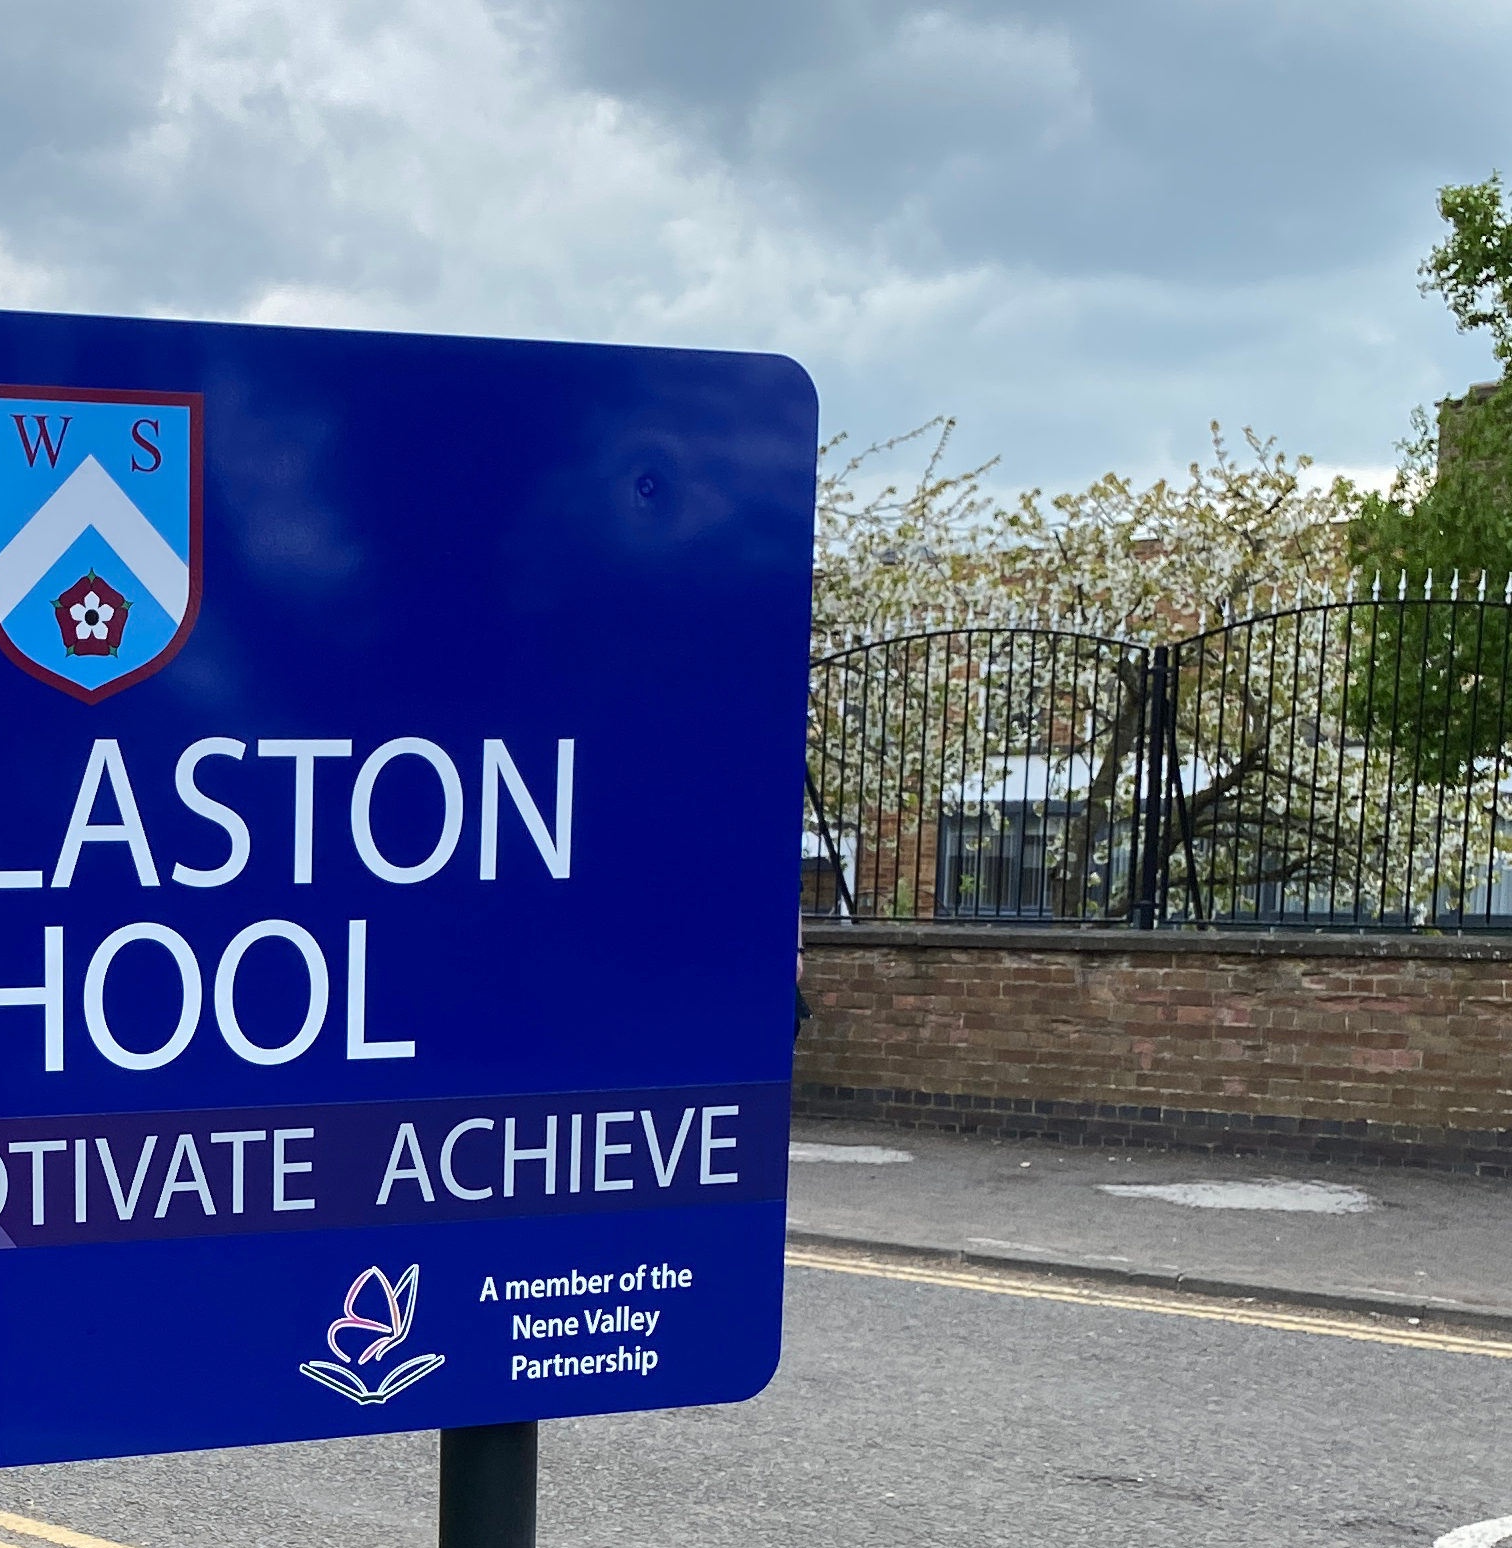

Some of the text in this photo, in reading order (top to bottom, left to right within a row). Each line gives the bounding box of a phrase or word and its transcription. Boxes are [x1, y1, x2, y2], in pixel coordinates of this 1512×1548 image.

[10, 414, 162, 472] W S
[375, 1105, 740, 1206] ACHIEVE
[479, 1262, 693, 1302] A member of the
[512, 1305, 661, 1340] Nene Valley
[511, 1345, 658, 1381] Partnership
